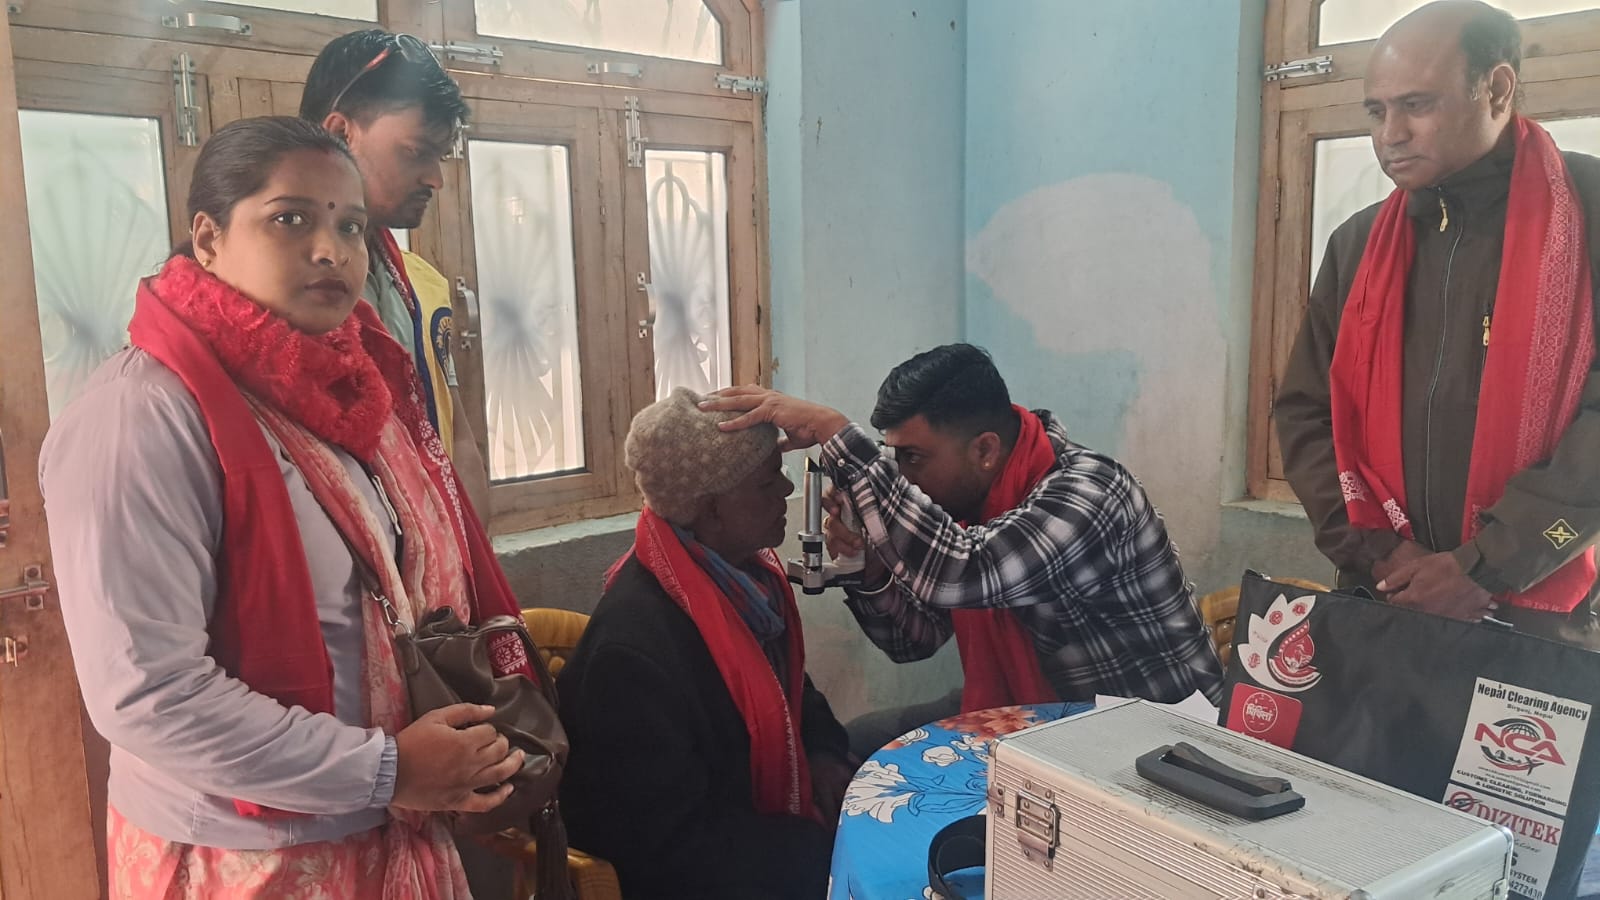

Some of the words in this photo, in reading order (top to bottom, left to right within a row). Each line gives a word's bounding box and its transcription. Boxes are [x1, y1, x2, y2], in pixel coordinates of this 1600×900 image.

[1478, 683, 1506, 699] Nepal
[1508, 691, 1550, 711] Clearing
[1550, 701, 1588, 720] Agency
[1474, 722, 1566, 766] NCA
[1457, 769, 1488, 783] CUSTOMS
[1525, 790, 1568, 807] FORWARDING
[1482, 782, 1513, 796] LOGISTIC
[1514, 792, 1546, 807] SOLUTION
[1476, 803, 1561, 846] DIZITEK
